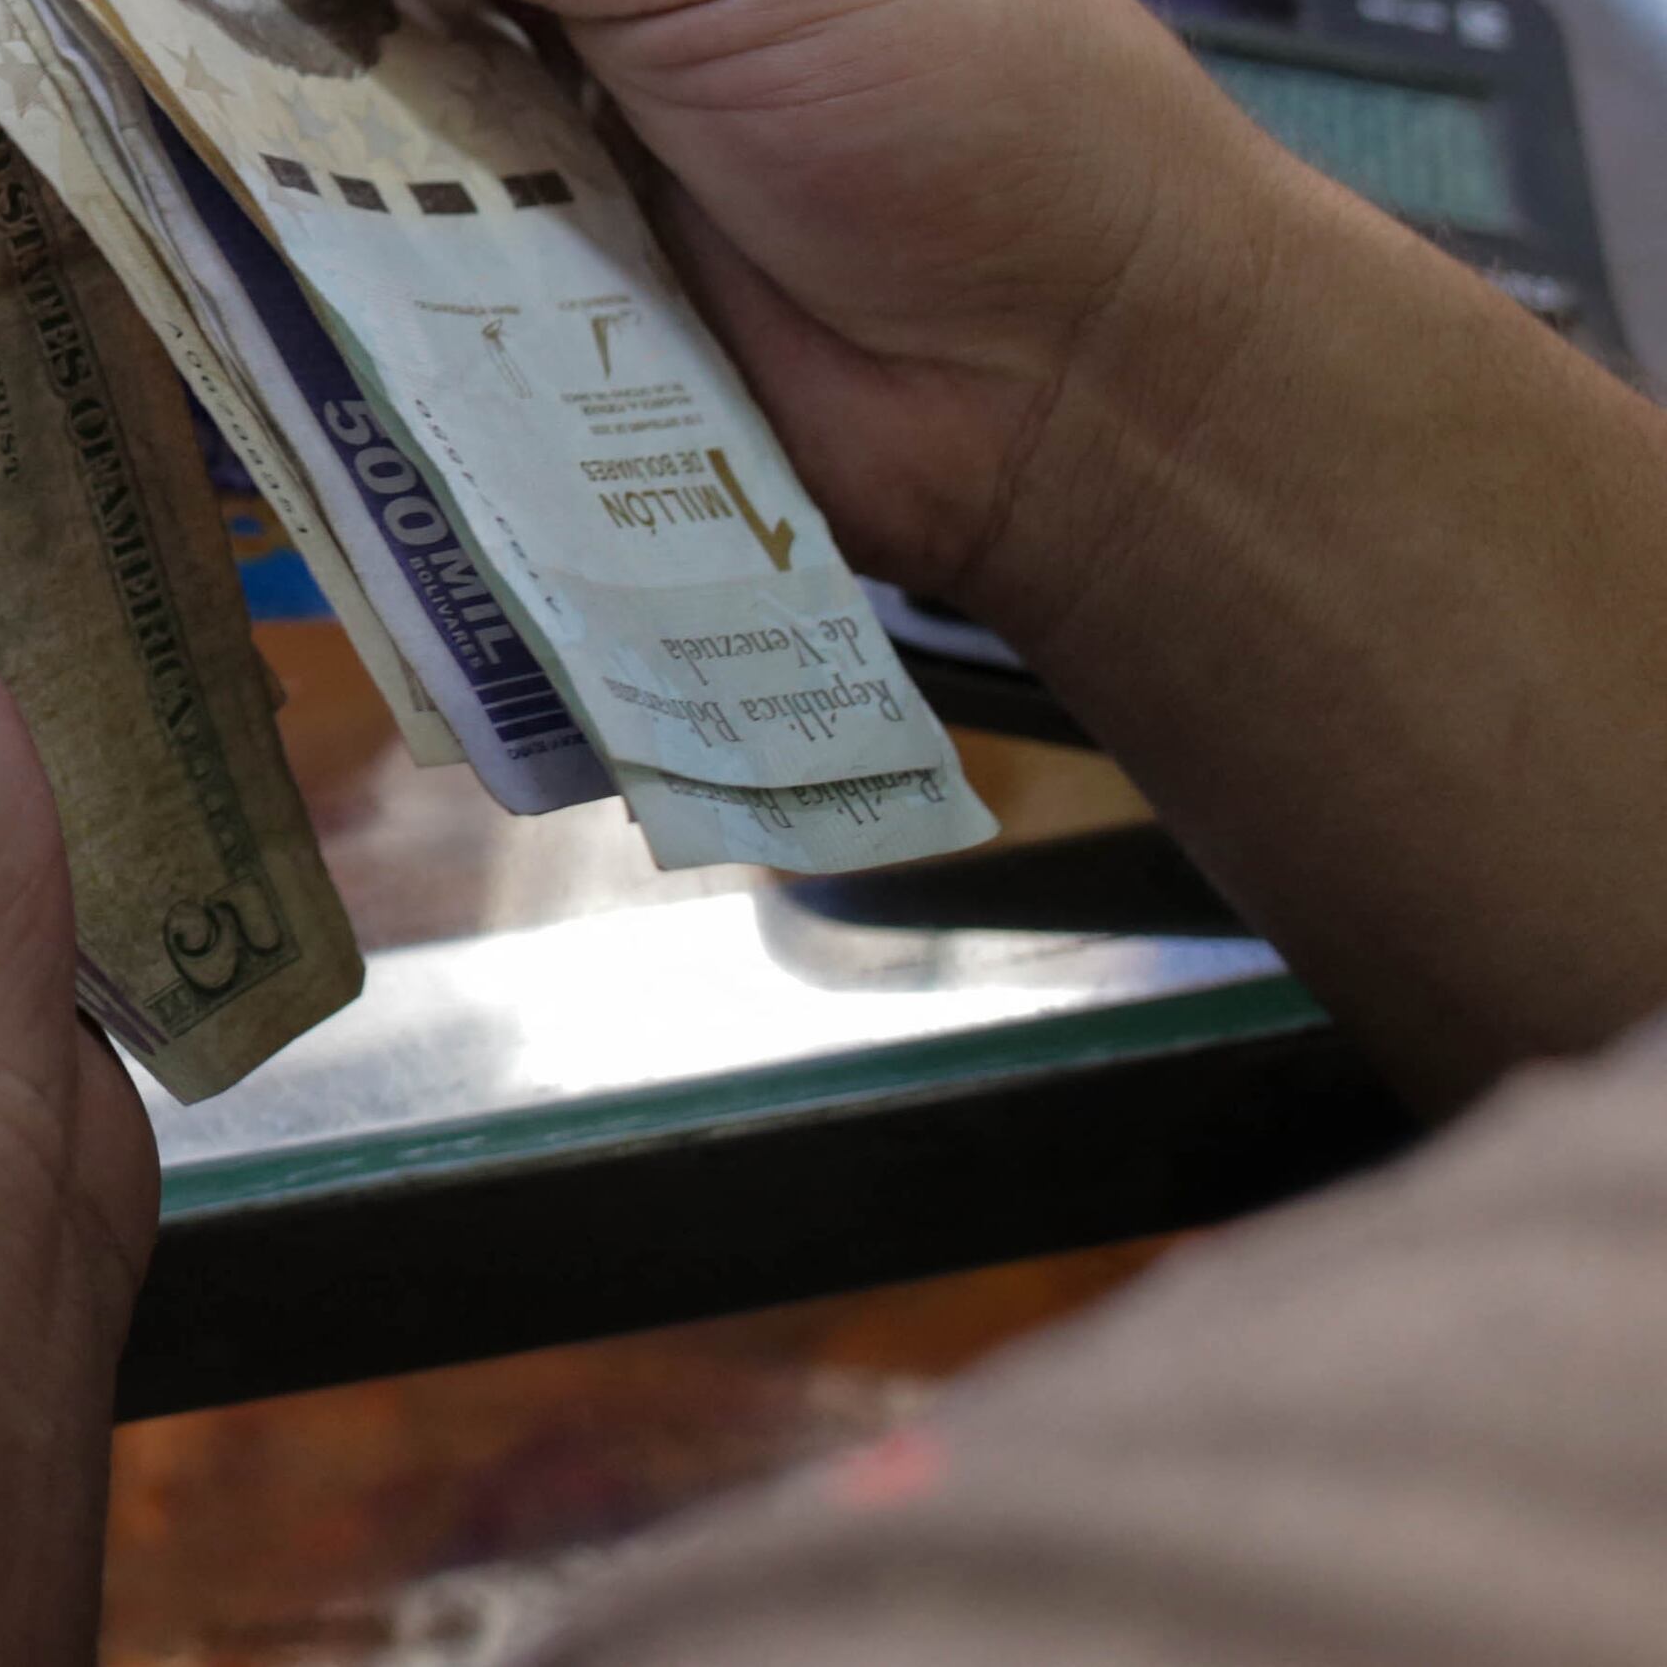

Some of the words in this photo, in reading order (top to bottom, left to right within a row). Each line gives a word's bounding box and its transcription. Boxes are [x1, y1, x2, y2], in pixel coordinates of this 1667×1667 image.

[69, 396, 125, 476] OF
[675, 449, 707, 474] DE
[323, 398, 450, 547] 500
[427, 546, 516, 665] MIL
[597, 484, 734, 536] MILLÓN
[407, 555, 484, 669] BOLIVARES
[817, 615, 868, 667] de
[658, 625, 828, 687] Venezuela
[739, 673, 907, 743] República
[163, 874, 284, 998] 5
